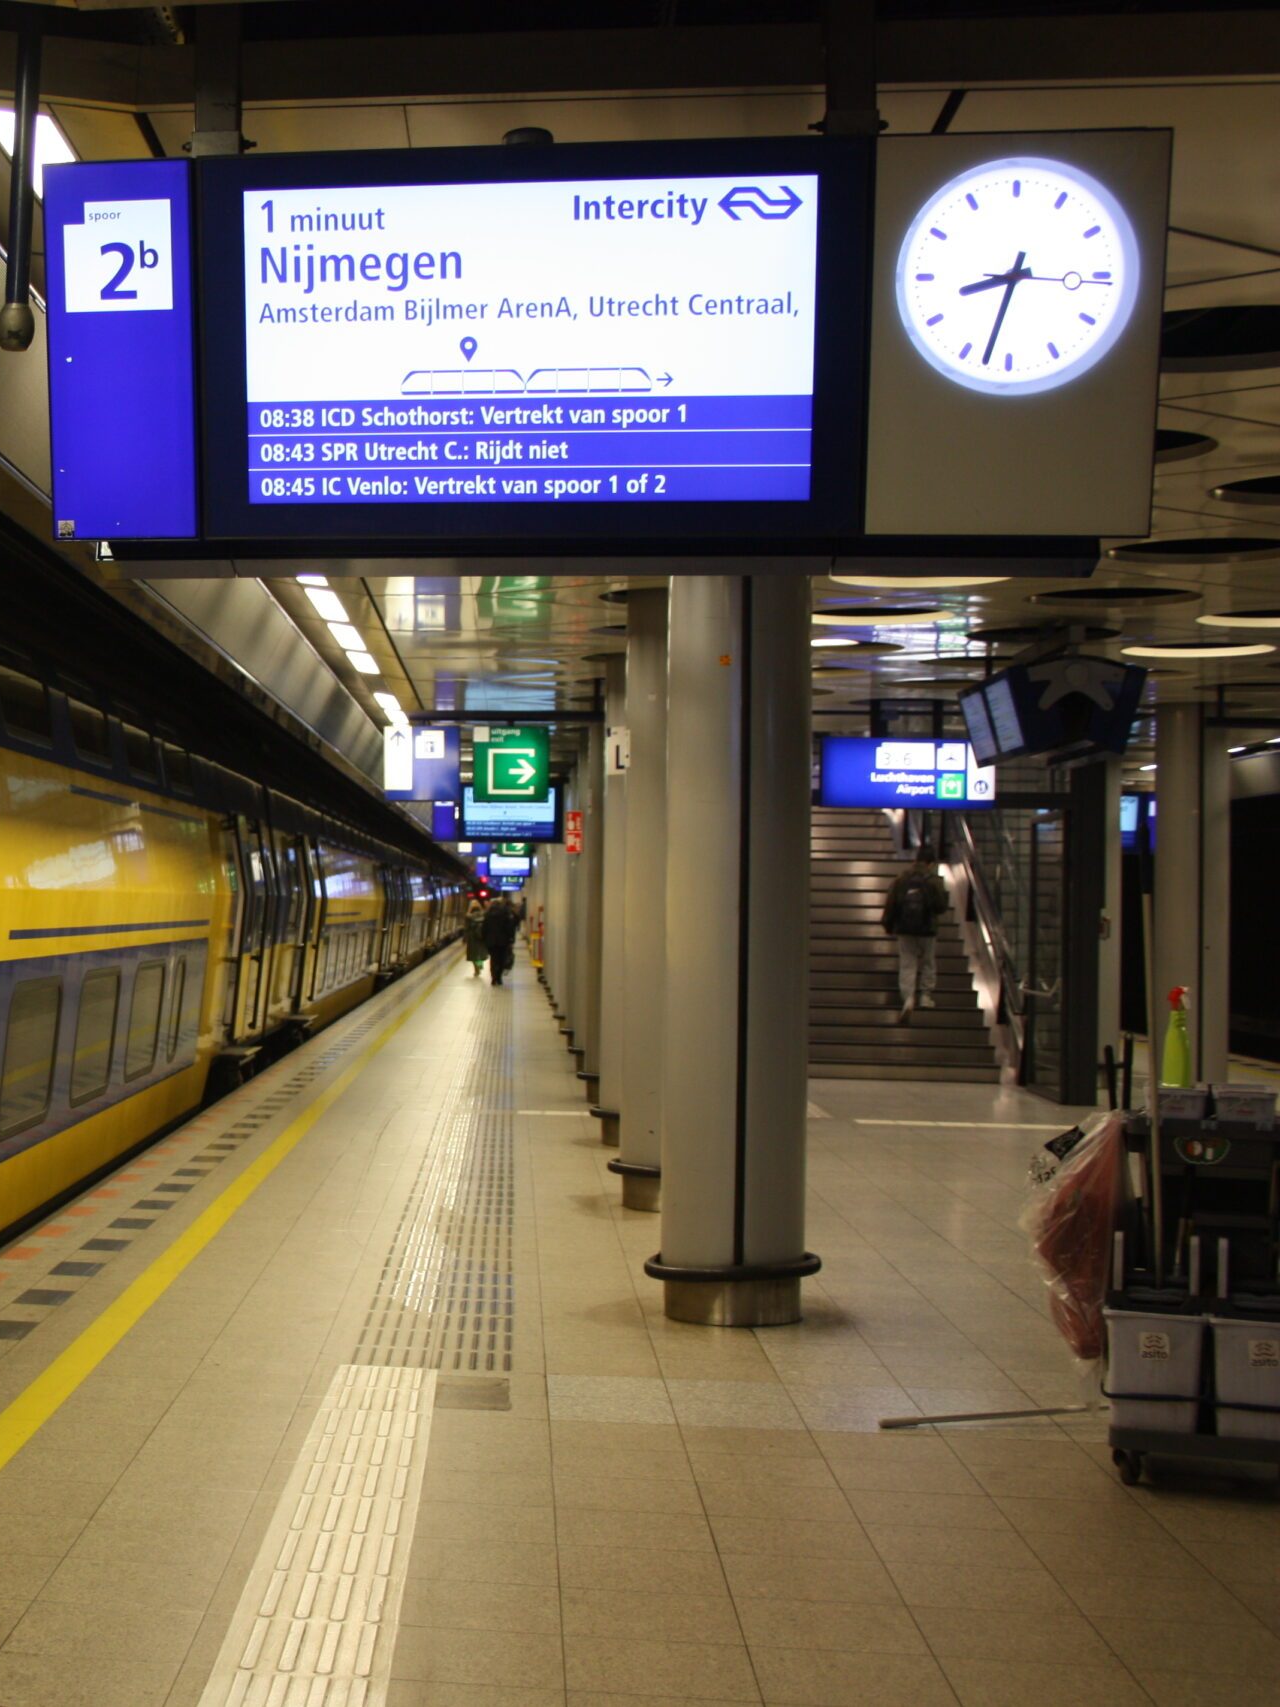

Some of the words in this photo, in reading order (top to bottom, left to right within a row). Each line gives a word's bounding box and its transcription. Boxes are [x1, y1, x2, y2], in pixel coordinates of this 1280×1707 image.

[88, 211, 121, 222] spoor
[260, 199, 274, 233] 1
[290, 206, 385, 232] minuut
[573, 190, 708, 226] Intercity
[260, 243, 462, 294] Nijmegen
[259, 299, 395, 324] Amsterdam
[404, 298, 488, 327] Bijlmer
[497, 296, 578, 321] ArenA,
[589, 293, 679, 318] Utrecht
[688, 291, 799, 318] Centraal,
[260, 408, 315, 428] 08:38
[321, 407, 355, 427] ICD
[361, 405, 474, 427] Schothorst:
[480, 404, 563, 425] Vertrekt
[569, 409, 606, 424] van
[612, 408, 670, 429] spoor
[677, 404, 686, 423] 1
[260, 443, 315, 462] 08:43
[321, 442, 358, 462] SPR
[365, 440, 438, 461] Utrecht
[444, 441, 469, 460] C.:
[476, 439, 523, 465] Rijdt
[529, 439, 569, 459] niet
[261, 477, 315, 497] 08:45
[322, 477, 341, 496] IC
[346, 475, 408, 496] Venlo:
[414, 474, 496, 495] Vertrekt
[501, 480, 538, 494] van
[544, 479, 602, 499] spoor
[609, 475, 617, 494] 1
[626, 473, 648, 494] of
[654, 474, 666, 493] 2
[491, 727, 521, 736] uitgang
[870, 772, 935, 783] Luchthaven
[896, 783, 935, 796] Airport
[1142, 1350, 1168, 1360] asito
